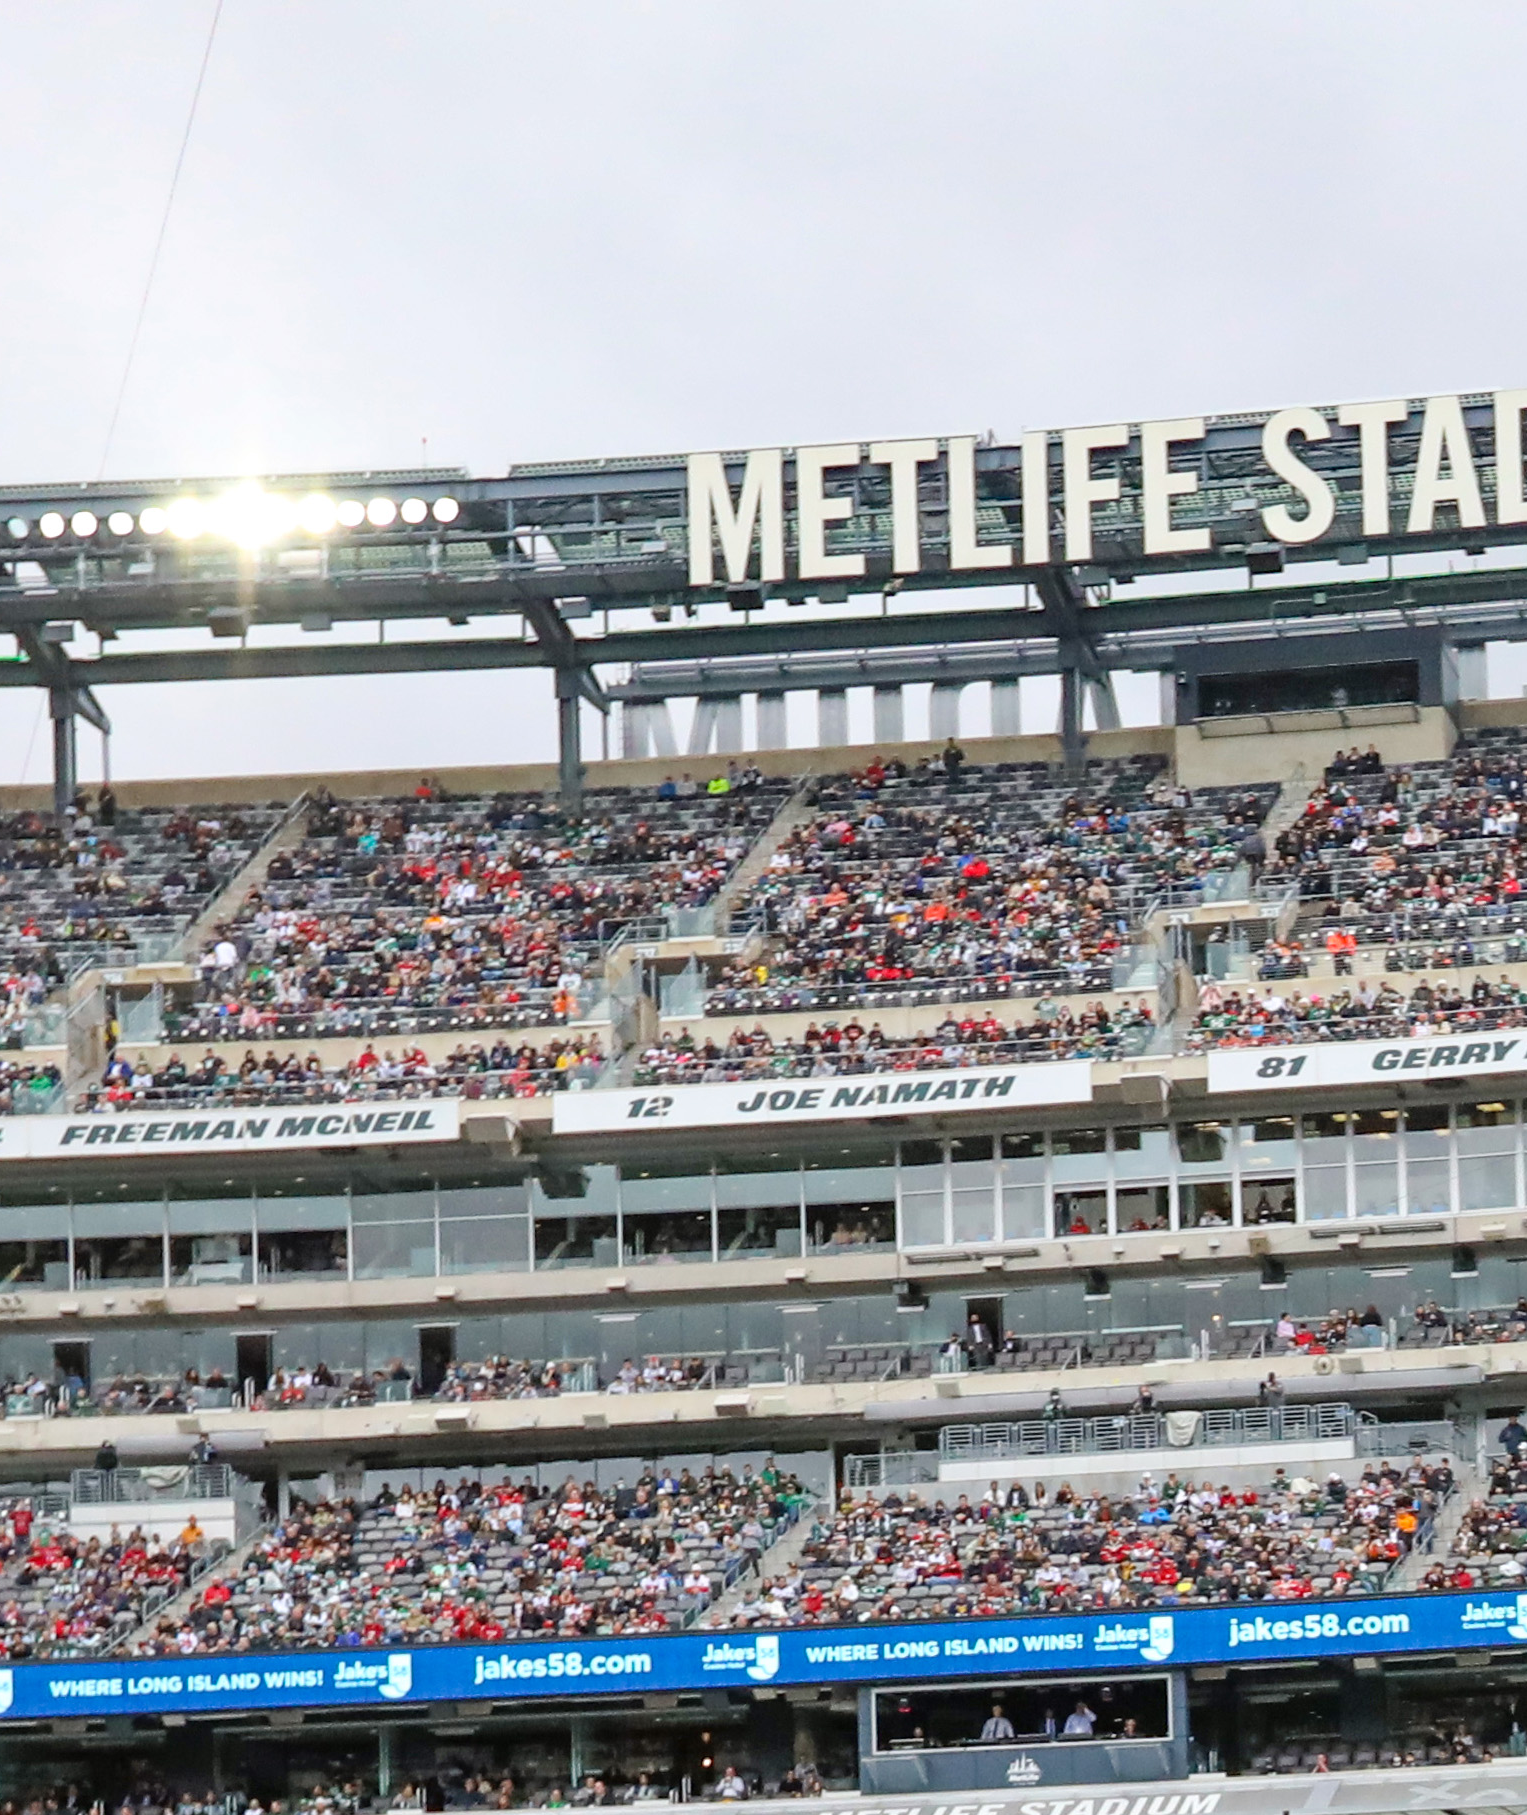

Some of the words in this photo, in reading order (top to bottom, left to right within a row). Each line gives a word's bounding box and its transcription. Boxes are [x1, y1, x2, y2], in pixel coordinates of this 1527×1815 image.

[688, 416, 1211, 586] METLIFE
[1256, 1055, 1309, 1079] 81
[1371, 1039, 1520, 1072] GERRY
[626, 1096, 675, 1119] 12
[737, 1088, 822, 1114] JOE
[830, 1075, 1019, 1109] NAMATH
[58, 1117, 271, 1146] FREEMAN
[275, 1109, 436, 1137] MCNEIL
[1460, 1601, 1518, 1622] Jake's
[1093, 1624, 1150, 1644] Jake's
[1228, 1612, 1410, 1647] jakes58.com
[702, 1642, 756, 1662] Jake's
[805, 1642, 879, 1663] WHERE
[881, 1640, 940, 1660] LONG
[944, 1635, 1019, 1656] ISLAND
[1022, 1632, 1084, 1652] WINS!
[49, 1678, 125, 1699] WHERE
[127, 1676, 184, 1696] LONG
[187, 1674, 260, 1693] ISLAND
[263, 1669, 324, 1688] WINS!
[333, 1661, 388, 1681] Jake's
[475, 1652, 651, 1685] jakes58.com
